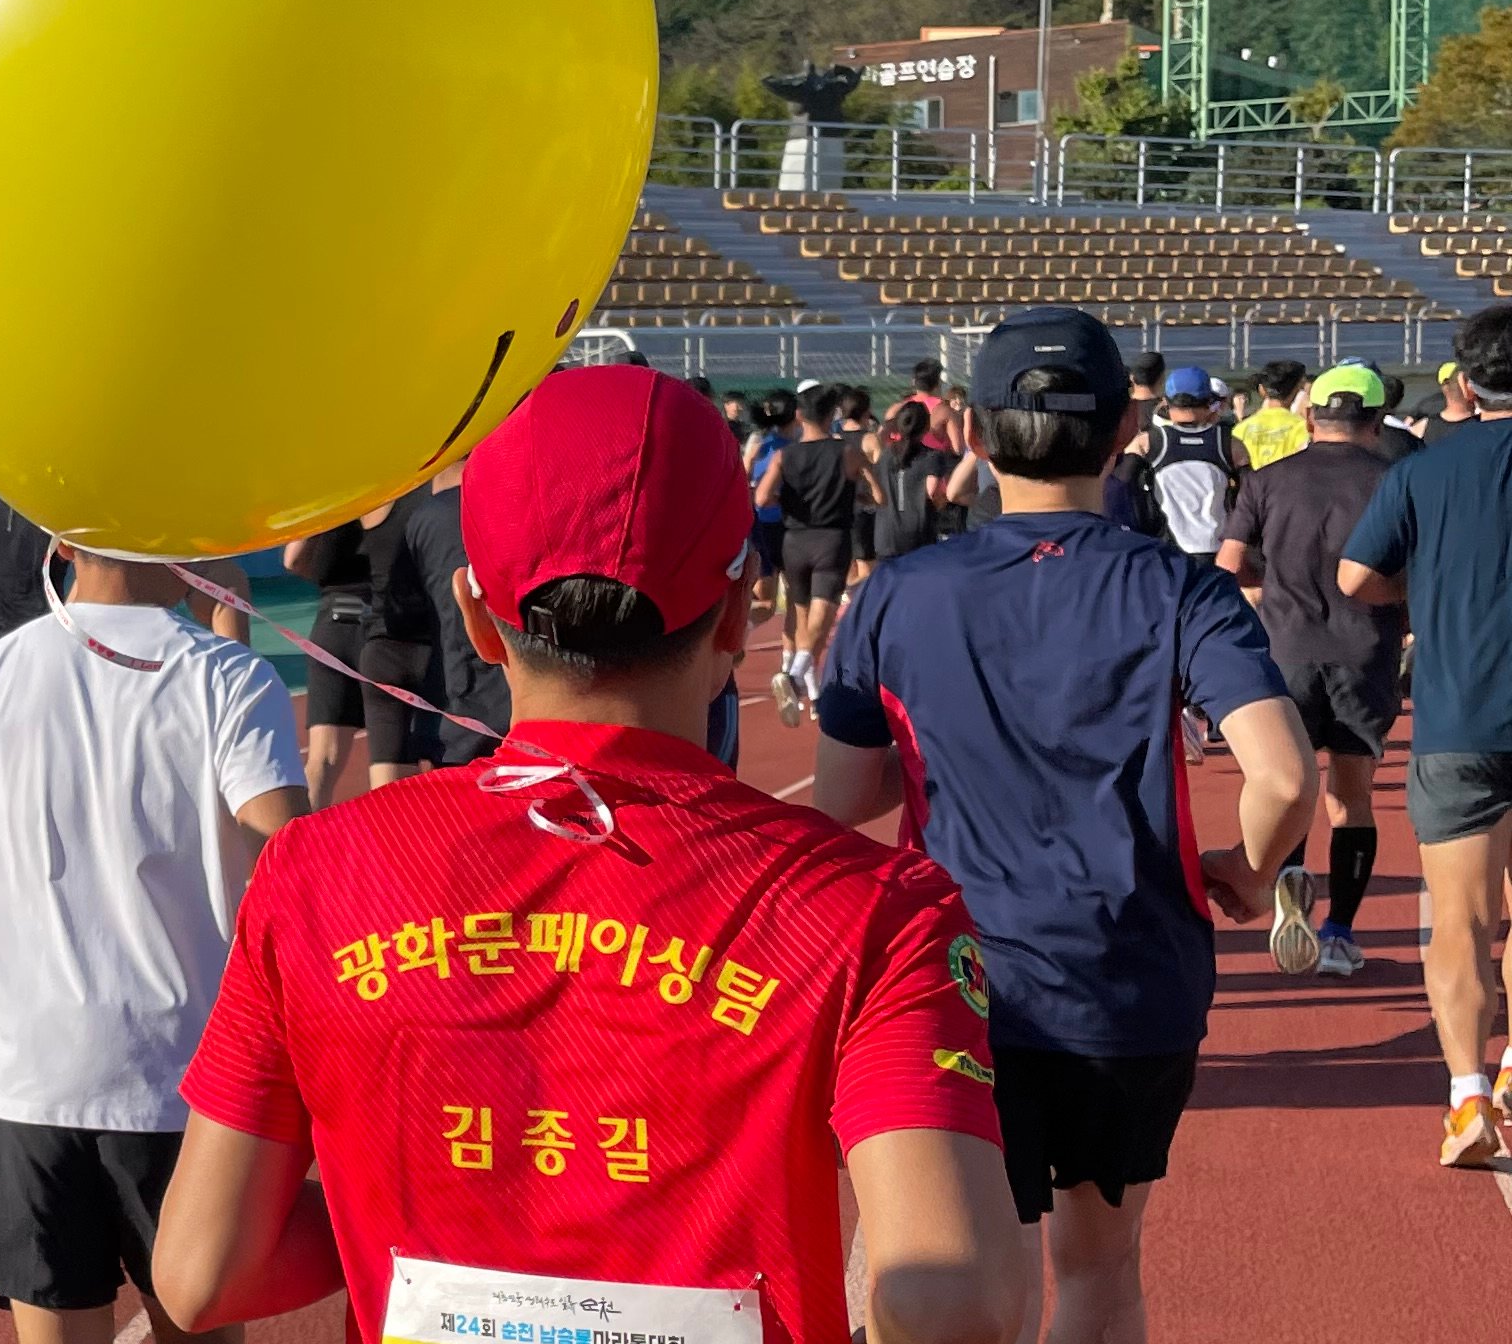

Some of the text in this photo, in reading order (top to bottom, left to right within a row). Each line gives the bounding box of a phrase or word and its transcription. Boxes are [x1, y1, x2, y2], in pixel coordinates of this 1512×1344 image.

[332, 912, 781, 1036] 광화문페이싱팀
[440, 1312, 496, 1338] 제24회
[501, 1320, 535, 1343] 순천
